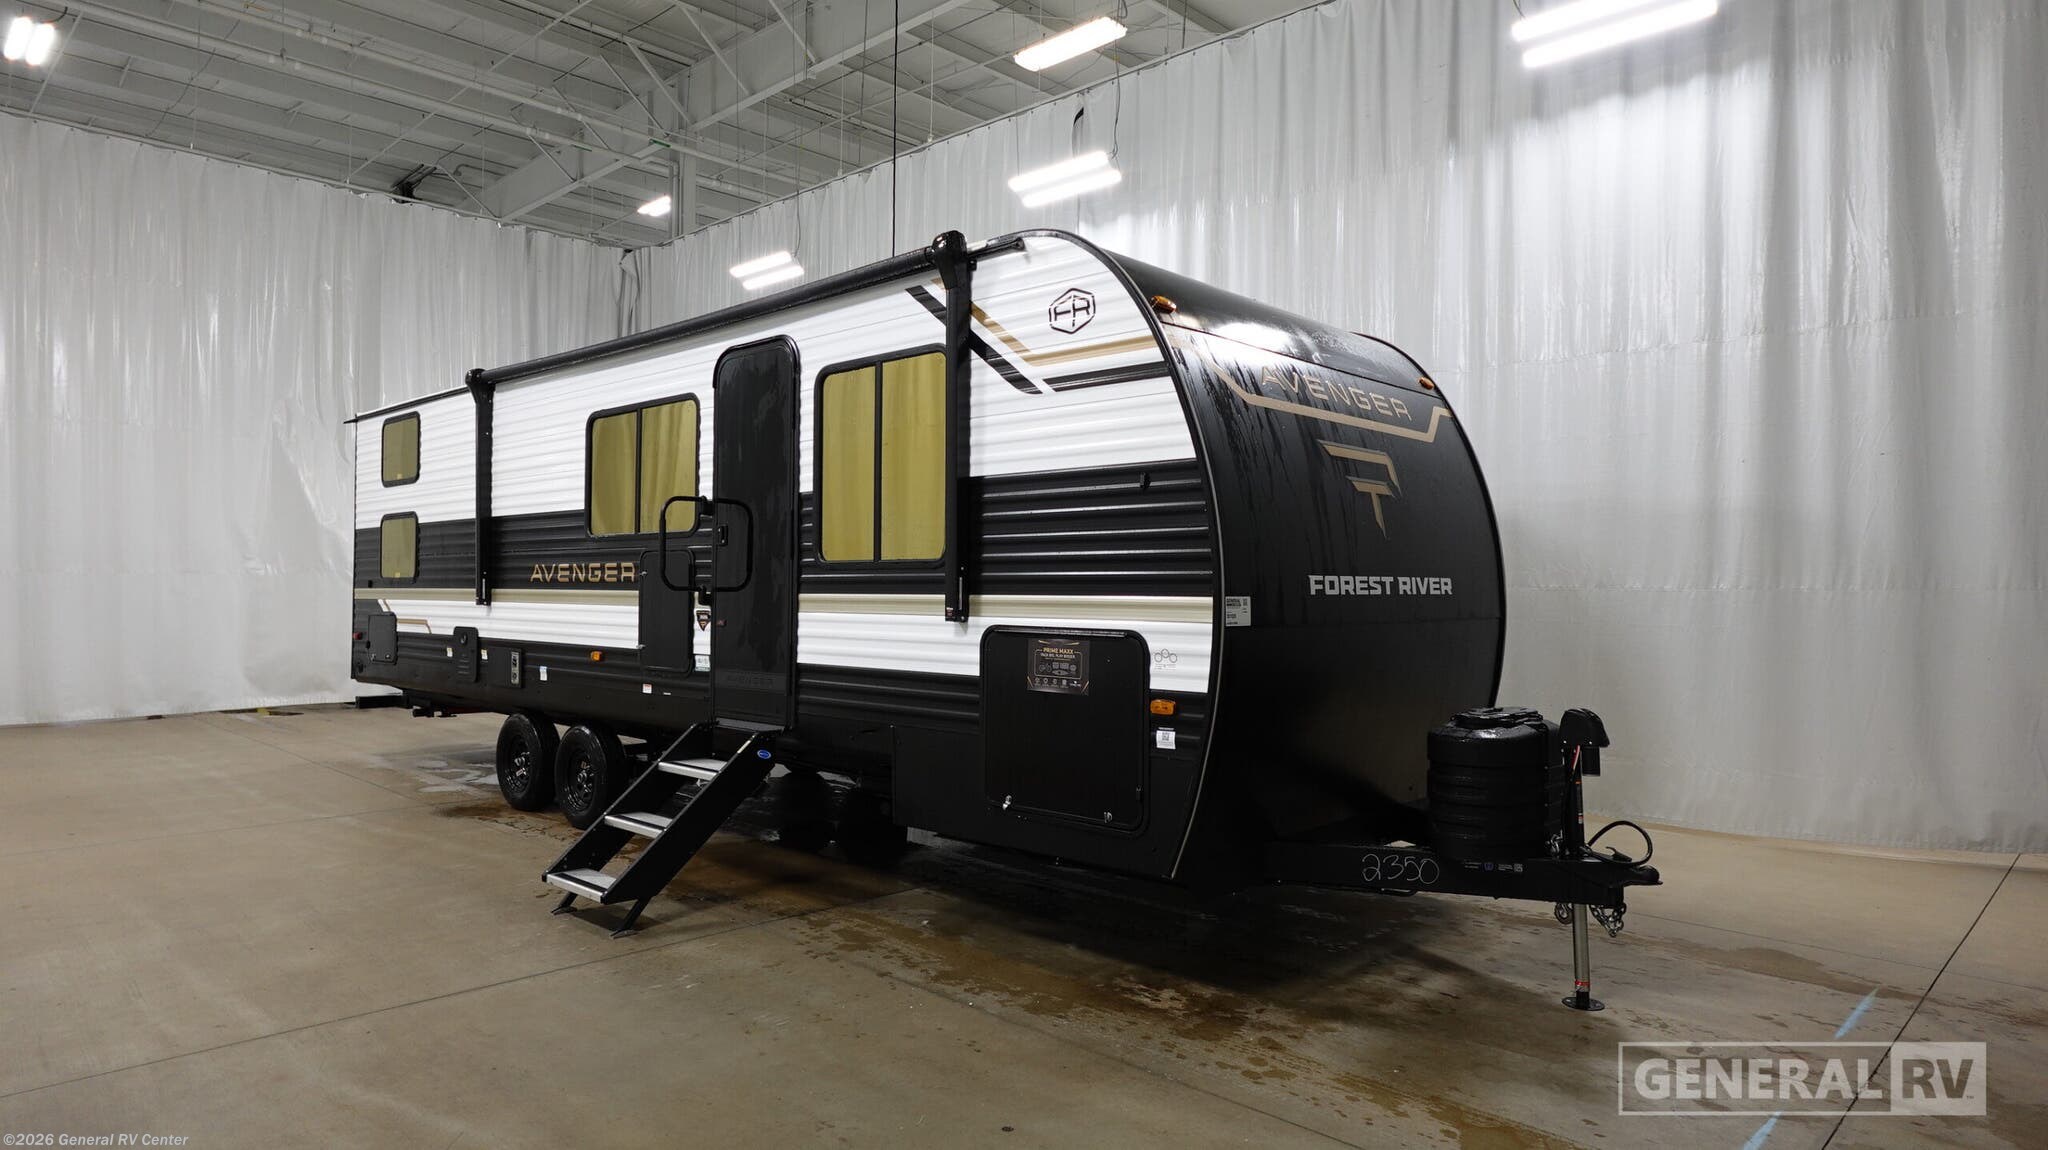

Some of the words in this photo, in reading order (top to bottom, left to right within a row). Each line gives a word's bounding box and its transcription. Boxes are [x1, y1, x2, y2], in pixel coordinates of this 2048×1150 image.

[1261, 365, 1412, 421] AVENGER
[530, 562, 636, 582] AVENGER
[1308, 574, 1394, 596] FOREST
[1397, 576, 1453, 596] RIVER
[1362, 853, 1440, 885] 2350
